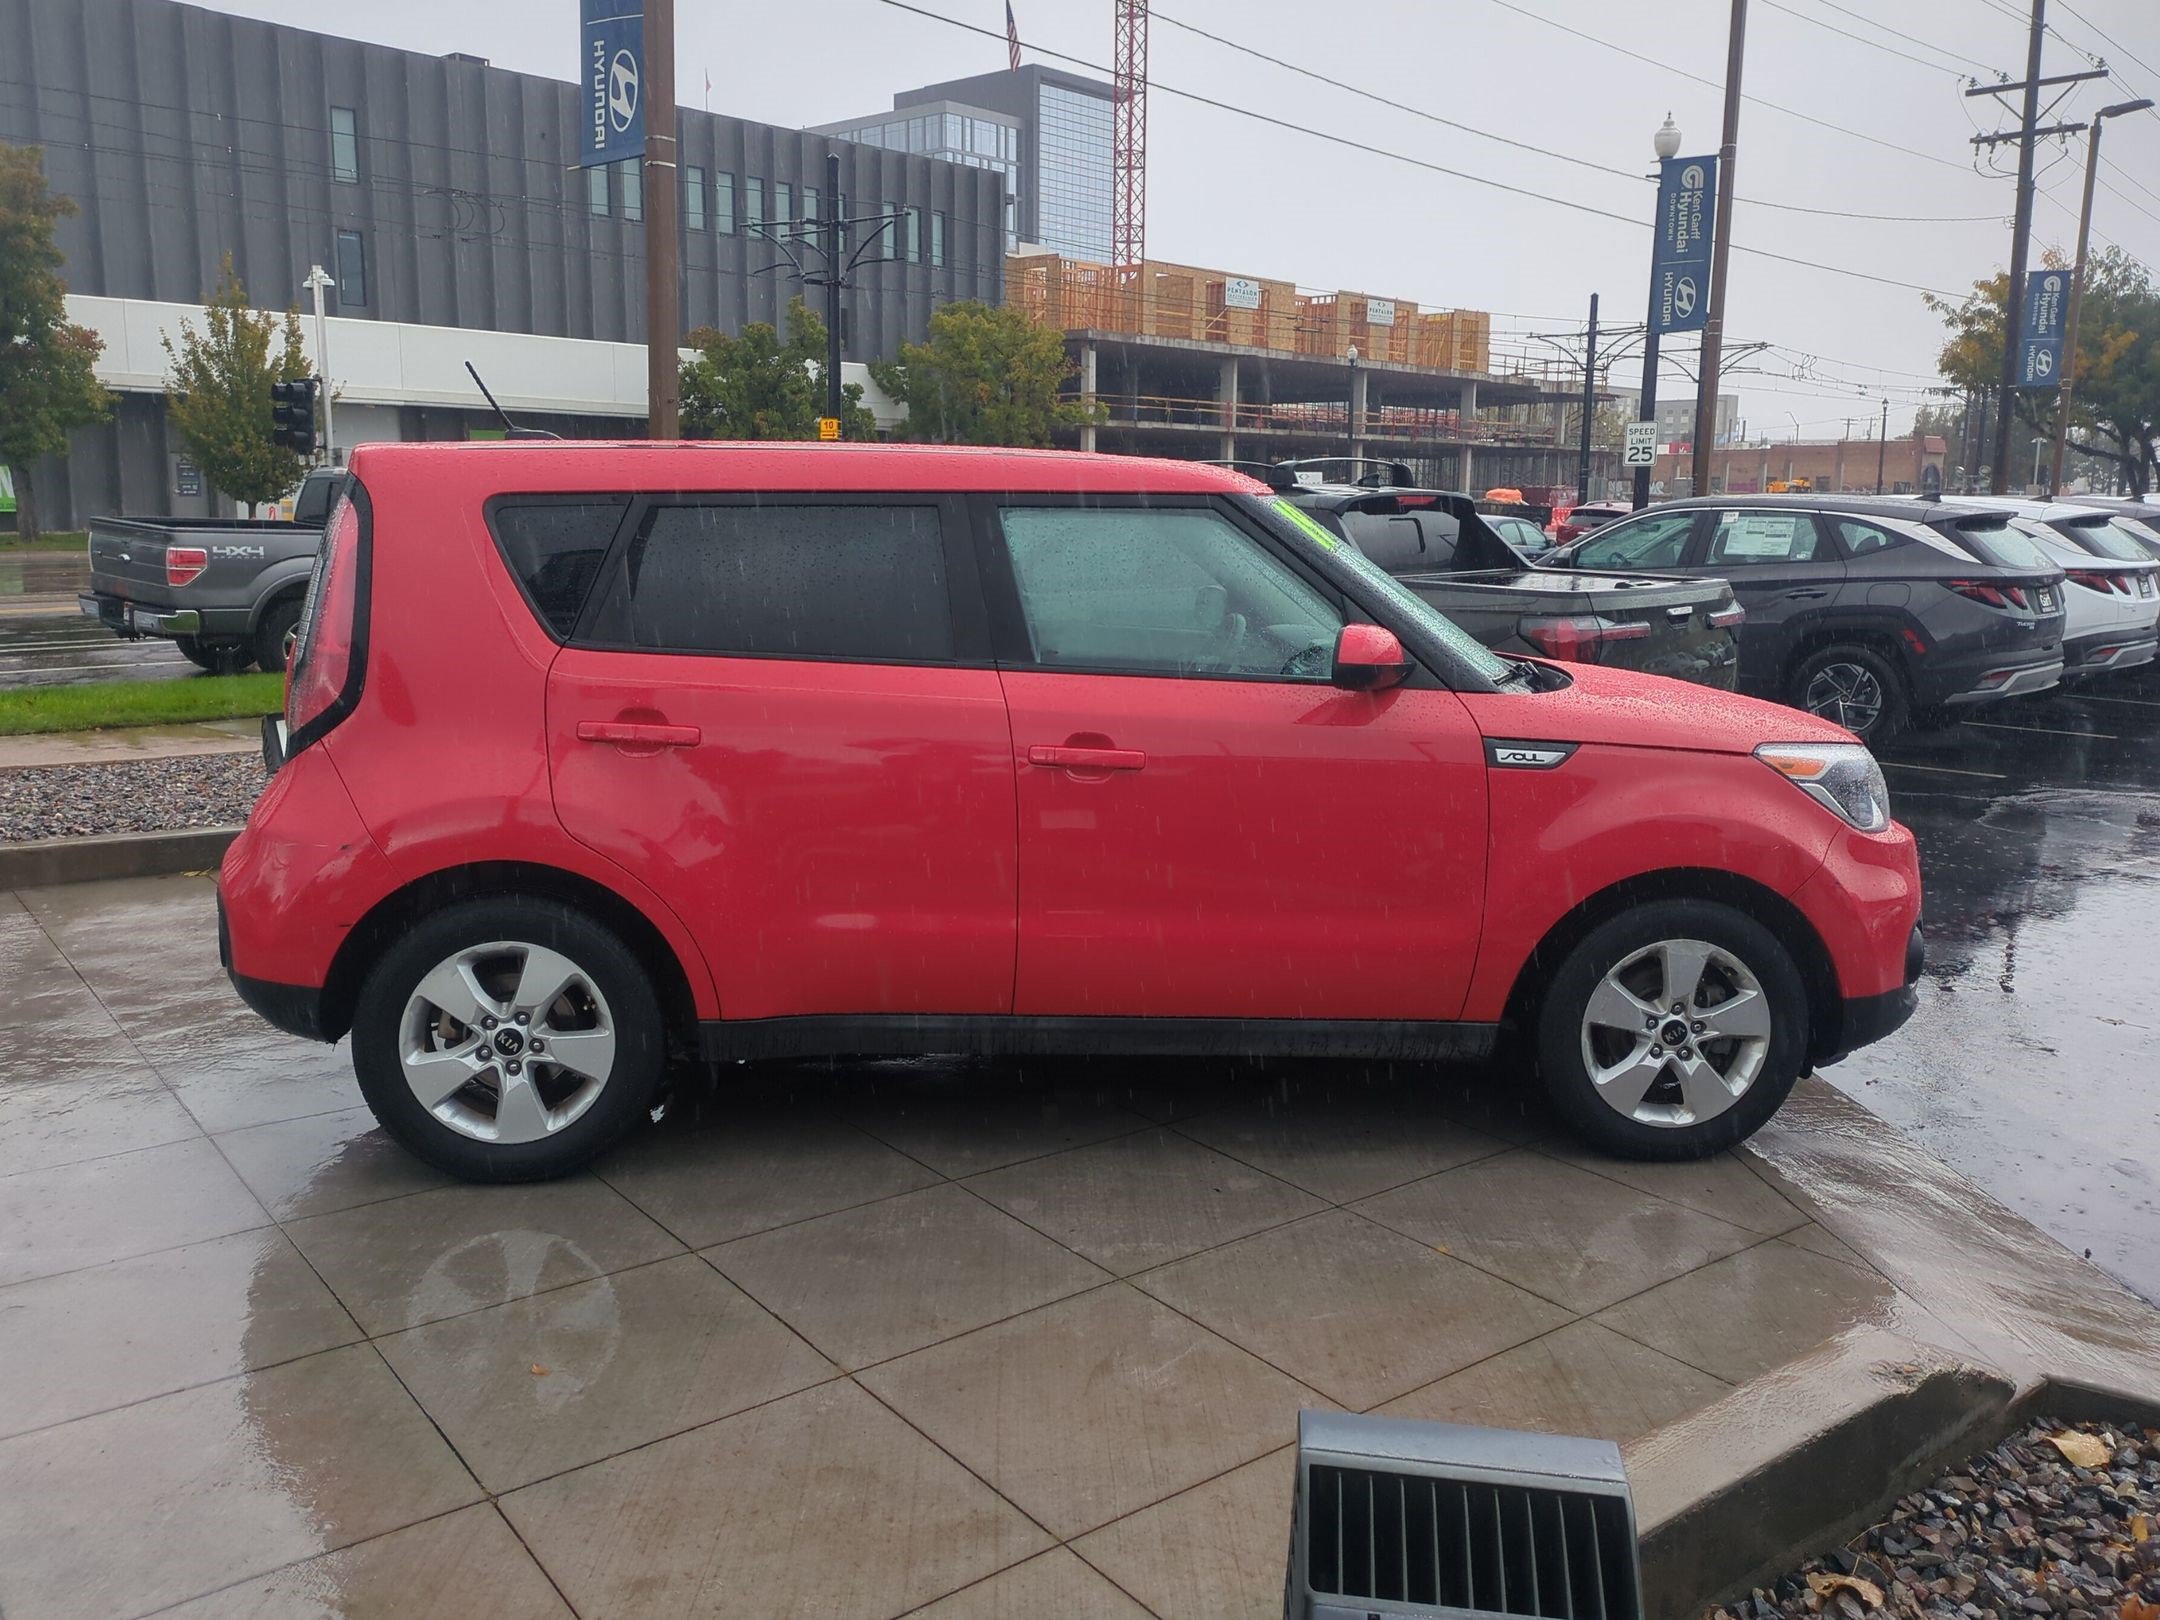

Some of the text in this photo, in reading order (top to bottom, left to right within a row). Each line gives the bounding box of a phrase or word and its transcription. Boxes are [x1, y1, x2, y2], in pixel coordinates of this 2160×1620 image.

[594, 40, 606, 149] HYUNDAI
[1668, 193, 1676, 240] DOWNTOWN
[1676, 191, 1692, 253] Hyundai
[1690, 190, 1703, 240] Ken Garff
[1662, 272, 1673, 326] HYUNDAI
[2038, 293, 2050, 334] Hyundai
[2026, 345, 2036, 382] HYUNDAI
[824, 421, 833, 429] 10
[1628, 446, 1653, 462] 25
[497, 1032, 519, 1053] KIA
[1664, 1026, 1686, 1042] KIA
